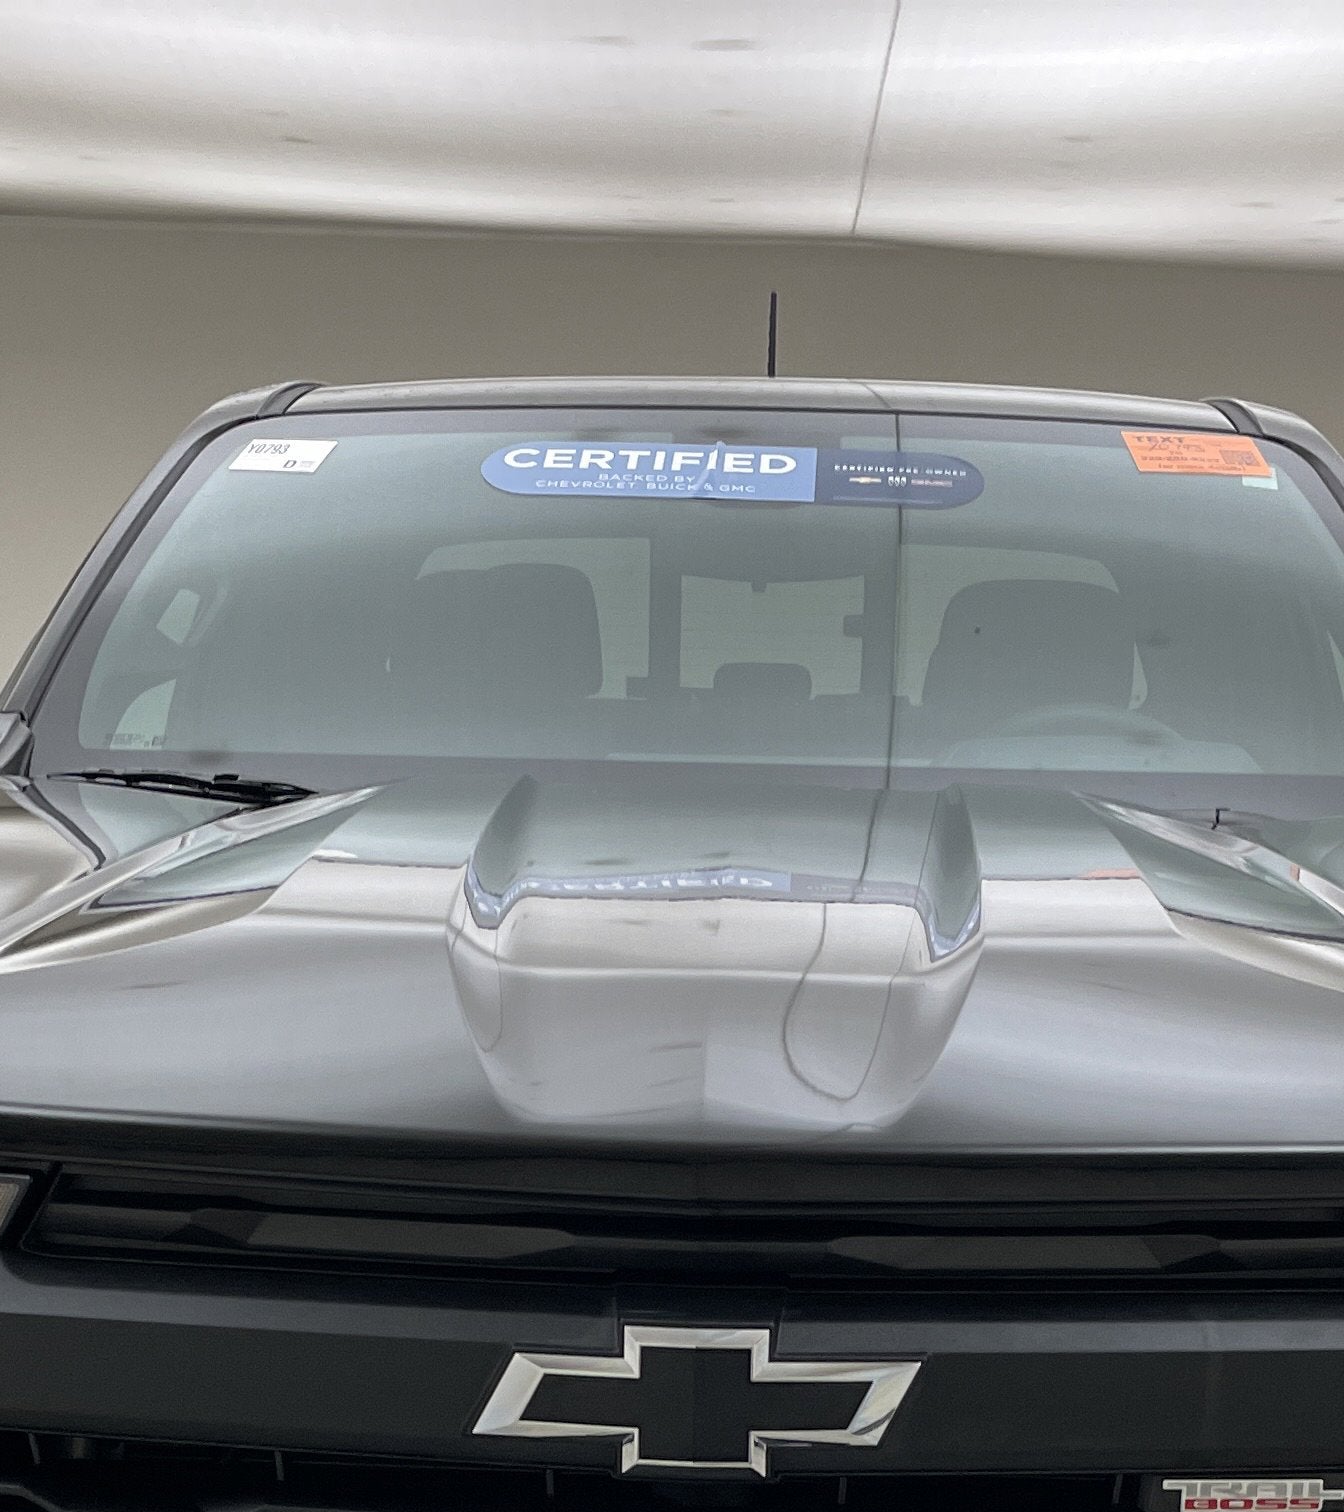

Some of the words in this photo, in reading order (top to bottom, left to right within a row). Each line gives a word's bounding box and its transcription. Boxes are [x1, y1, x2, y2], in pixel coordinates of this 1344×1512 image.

[1134, 436, 1186, 444] TEXT
[247, 443, 290, 455] Y0793
[283, 459, 296, 469] D
[504, 448, 797, 474] CERTIFIED
[598, 473, 668, 482] BACKED
[674, 475, 695, 483] BY
[535, 479, 636, 489] CHEVROLET
[646, 483, 698, 491] BUICK
[719, 484, 756, 493] GMC
[1162, 1479, 1344, 1500] TRAIL
[1182, 1498, 1322, 1512] BOSS
